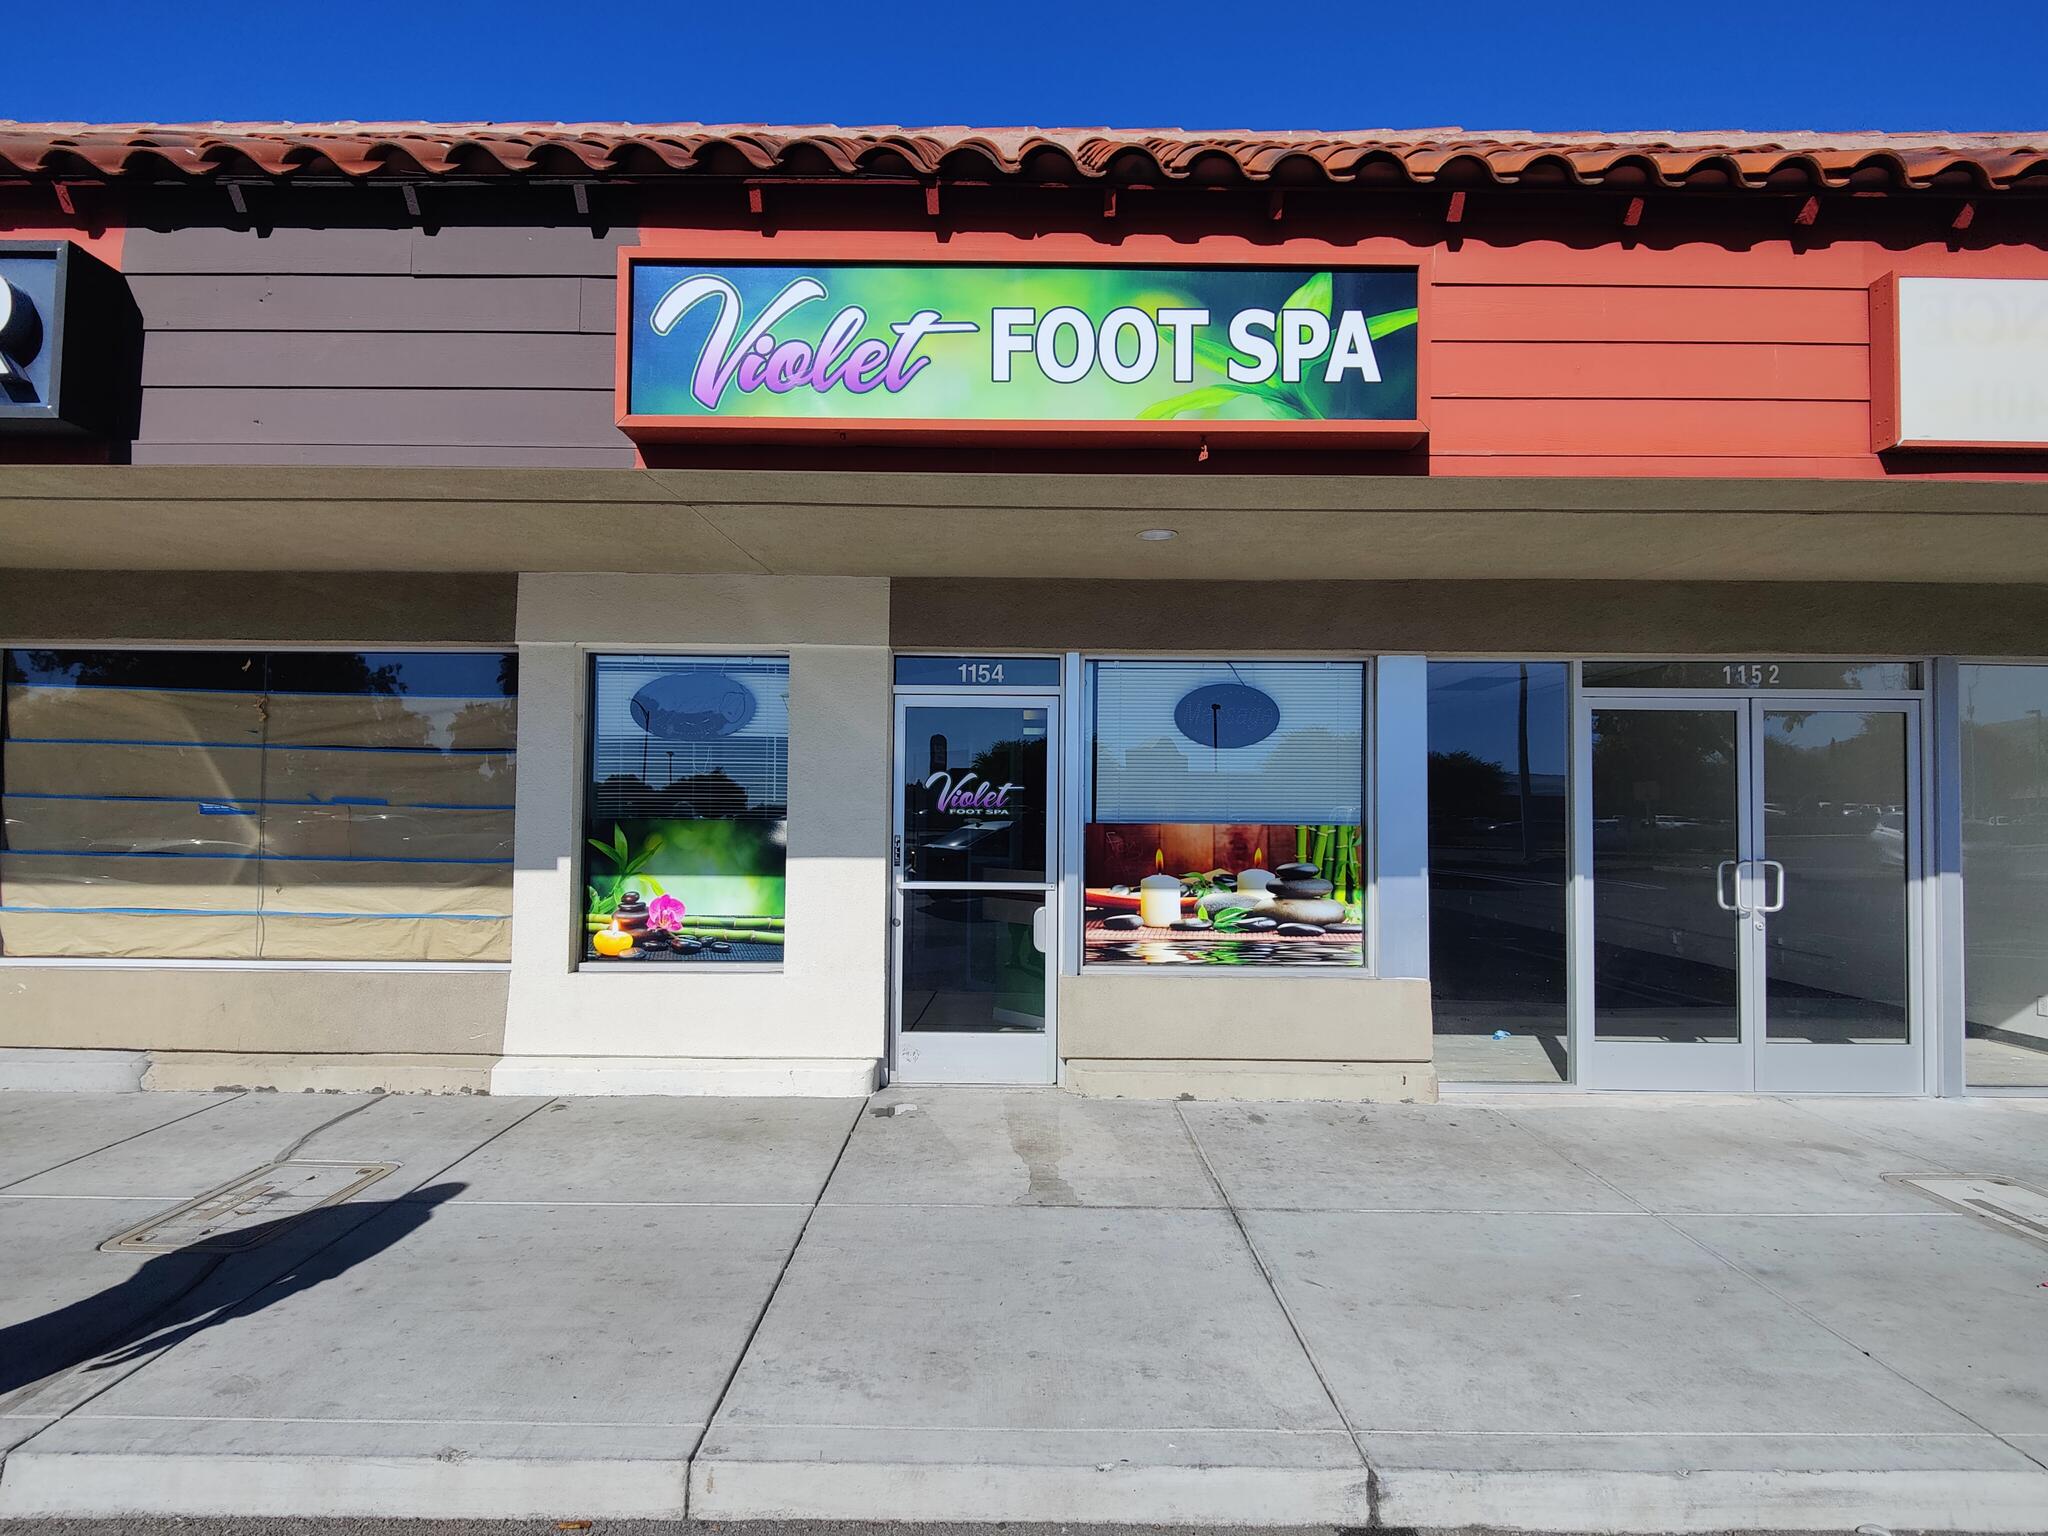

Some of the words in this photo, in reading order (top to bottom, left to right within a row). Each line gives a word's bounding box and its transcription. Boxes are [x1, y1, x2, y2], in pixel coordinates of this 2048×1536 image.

[650, 274, 979, 412] Violet
[990, 306, 1209, 384] FOOT
[1225, 306, 1384, 385] SPA
[957, 663, 1004, 683] 1154
[1722, 664, 1780, 684] 1152
[925, 771, 1025, 815] Violet
